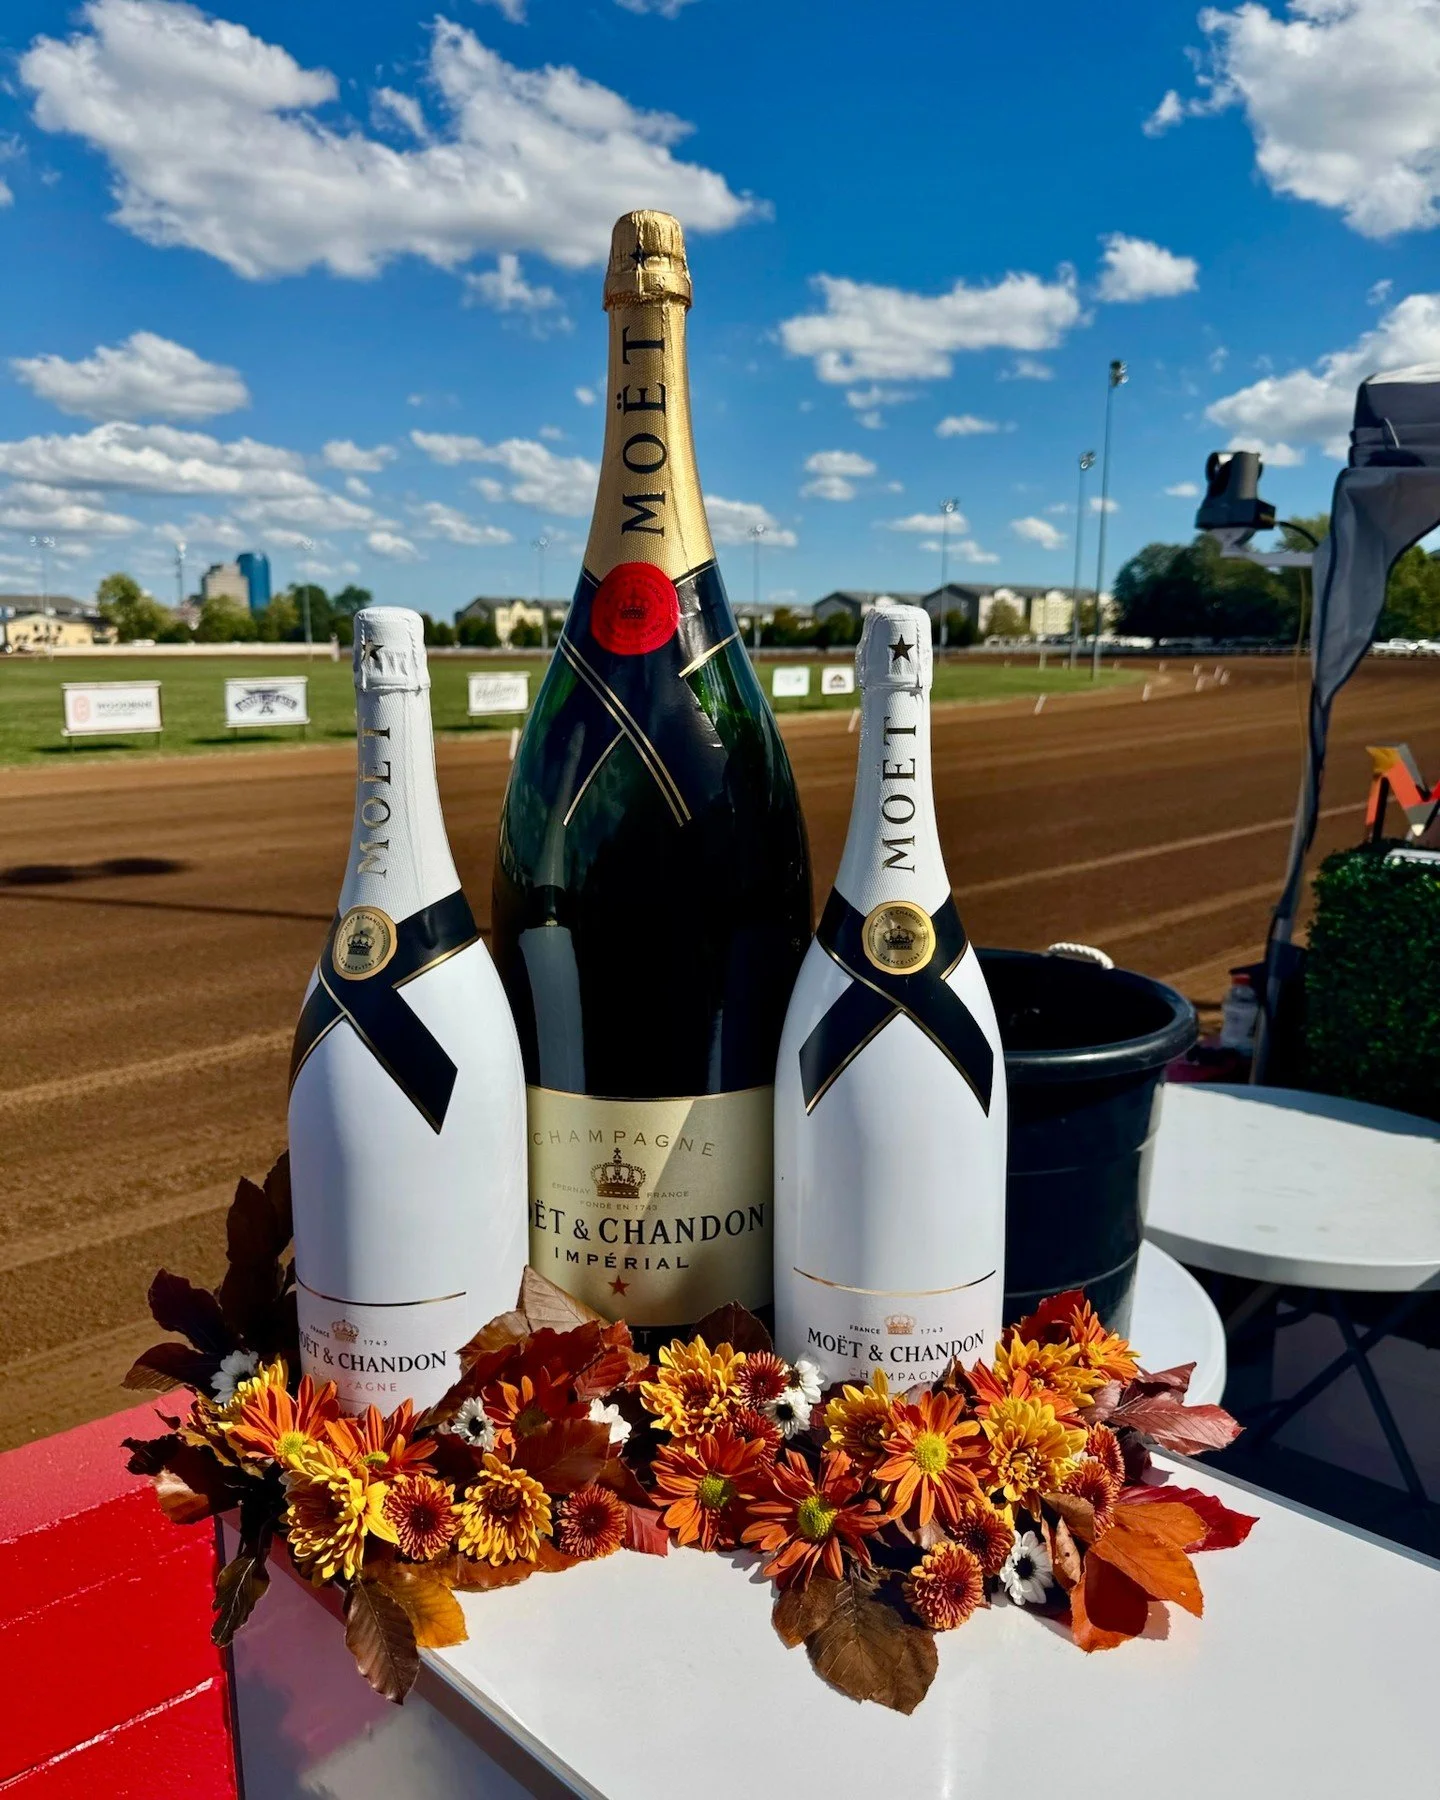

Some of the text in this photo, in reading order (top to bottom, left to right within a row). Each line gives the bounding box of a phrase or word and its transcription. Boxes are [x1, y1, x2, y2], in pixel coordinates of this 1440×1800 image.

[616, 326, 667, 537] MOËT
[533, 1129, 715, 1158] CHAMPAGNE
[551, 1181, 690, 1199] ÉPERNAY FRANCE
[617, 1203, 630, 1211] EN
[635, 1203, 659, 1212] 1743
[573, 1218, 591, 1241] &
[599, 1202, 765, 1245] CHANDON
[554, 1246, 690, 1270] IMPÉRIAL
[310, 1324, 389, 1347] FRANCE 1743
[849, 1324, 943, 1335] FRANCE 1743
[807, 1326, 985, 1363] MOËT & CHANDON
[323, 1347, 334, 1365] &
[338, 1350, 447, 1374] CHANDON
